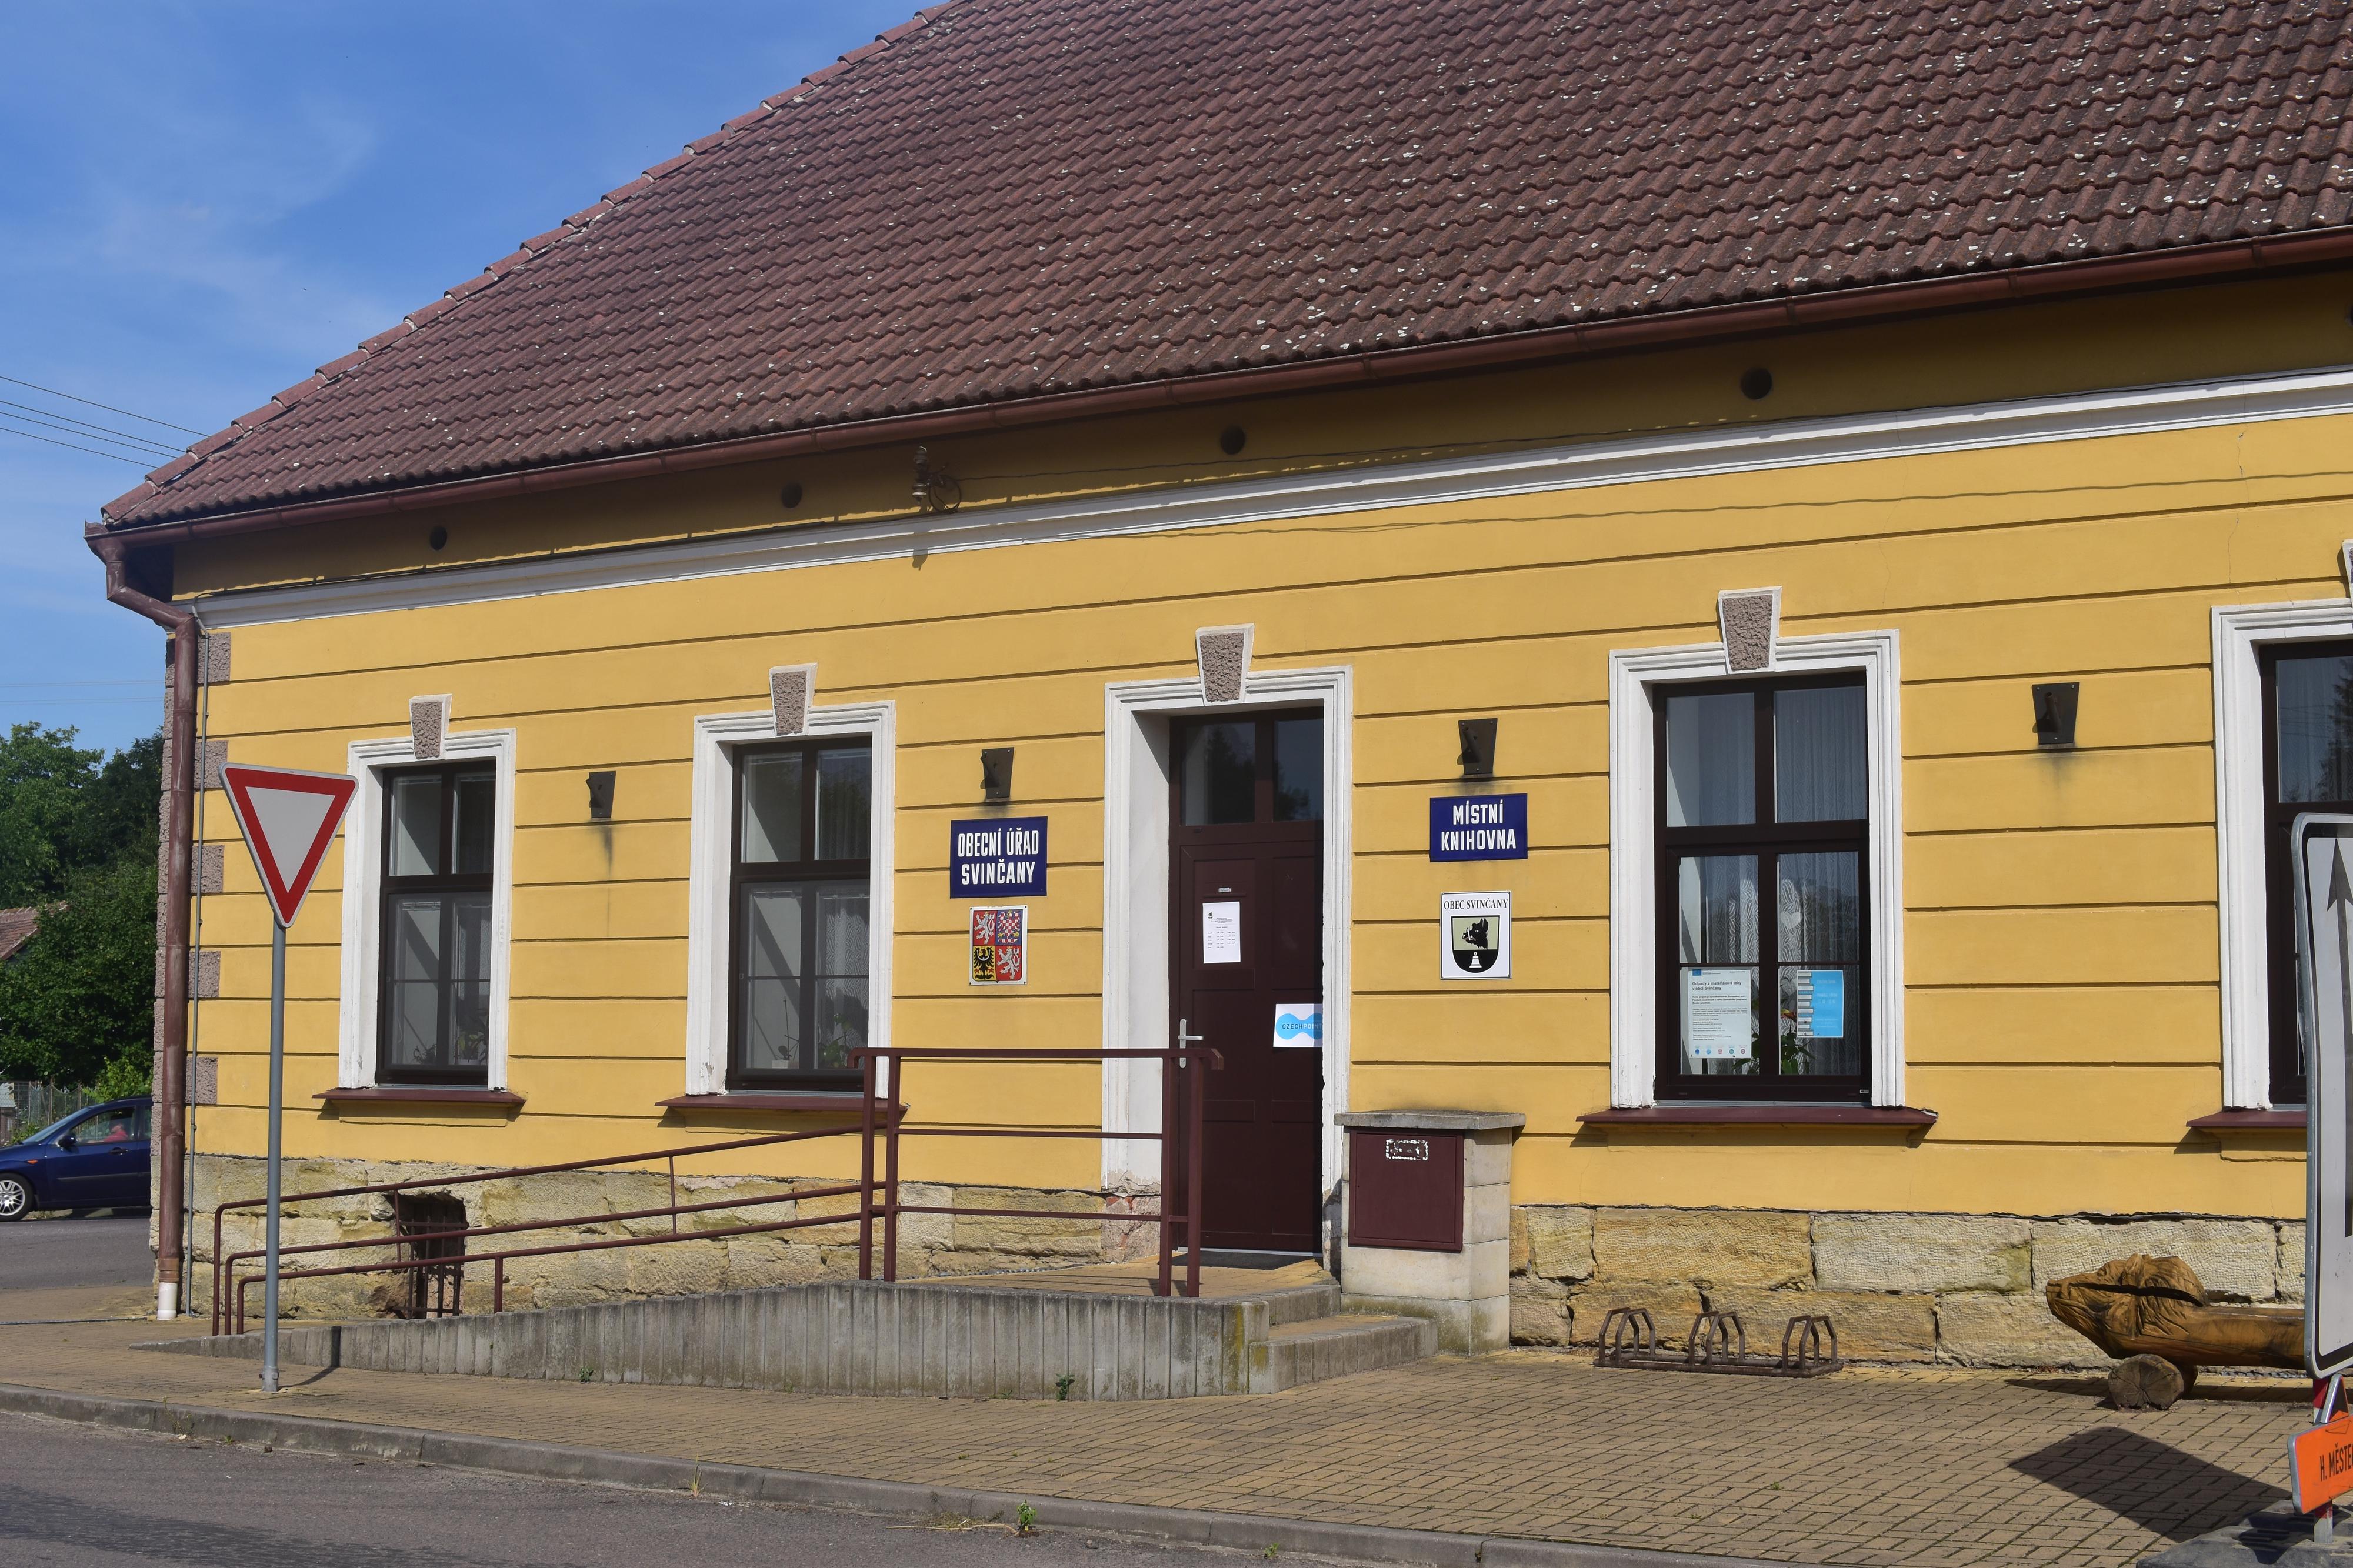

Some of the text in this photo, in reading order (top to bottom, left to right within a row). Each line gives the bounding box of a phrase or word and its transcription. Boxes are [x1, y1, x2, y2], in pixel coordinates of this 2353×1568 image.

[1452, 799, 1504, 825] MÍSTNÍ
[958, 827, 1039, 857] OBECNÍ ÚŘAD
[1441, 829, 1516, 851] KNIHOVNA
[961, 859, 1036, 885] SVINČANY
[1444, 897, 1508, 910] OBEC SVINČANY
[2319, 1442, 2353, 1482] H. MĚSTE
